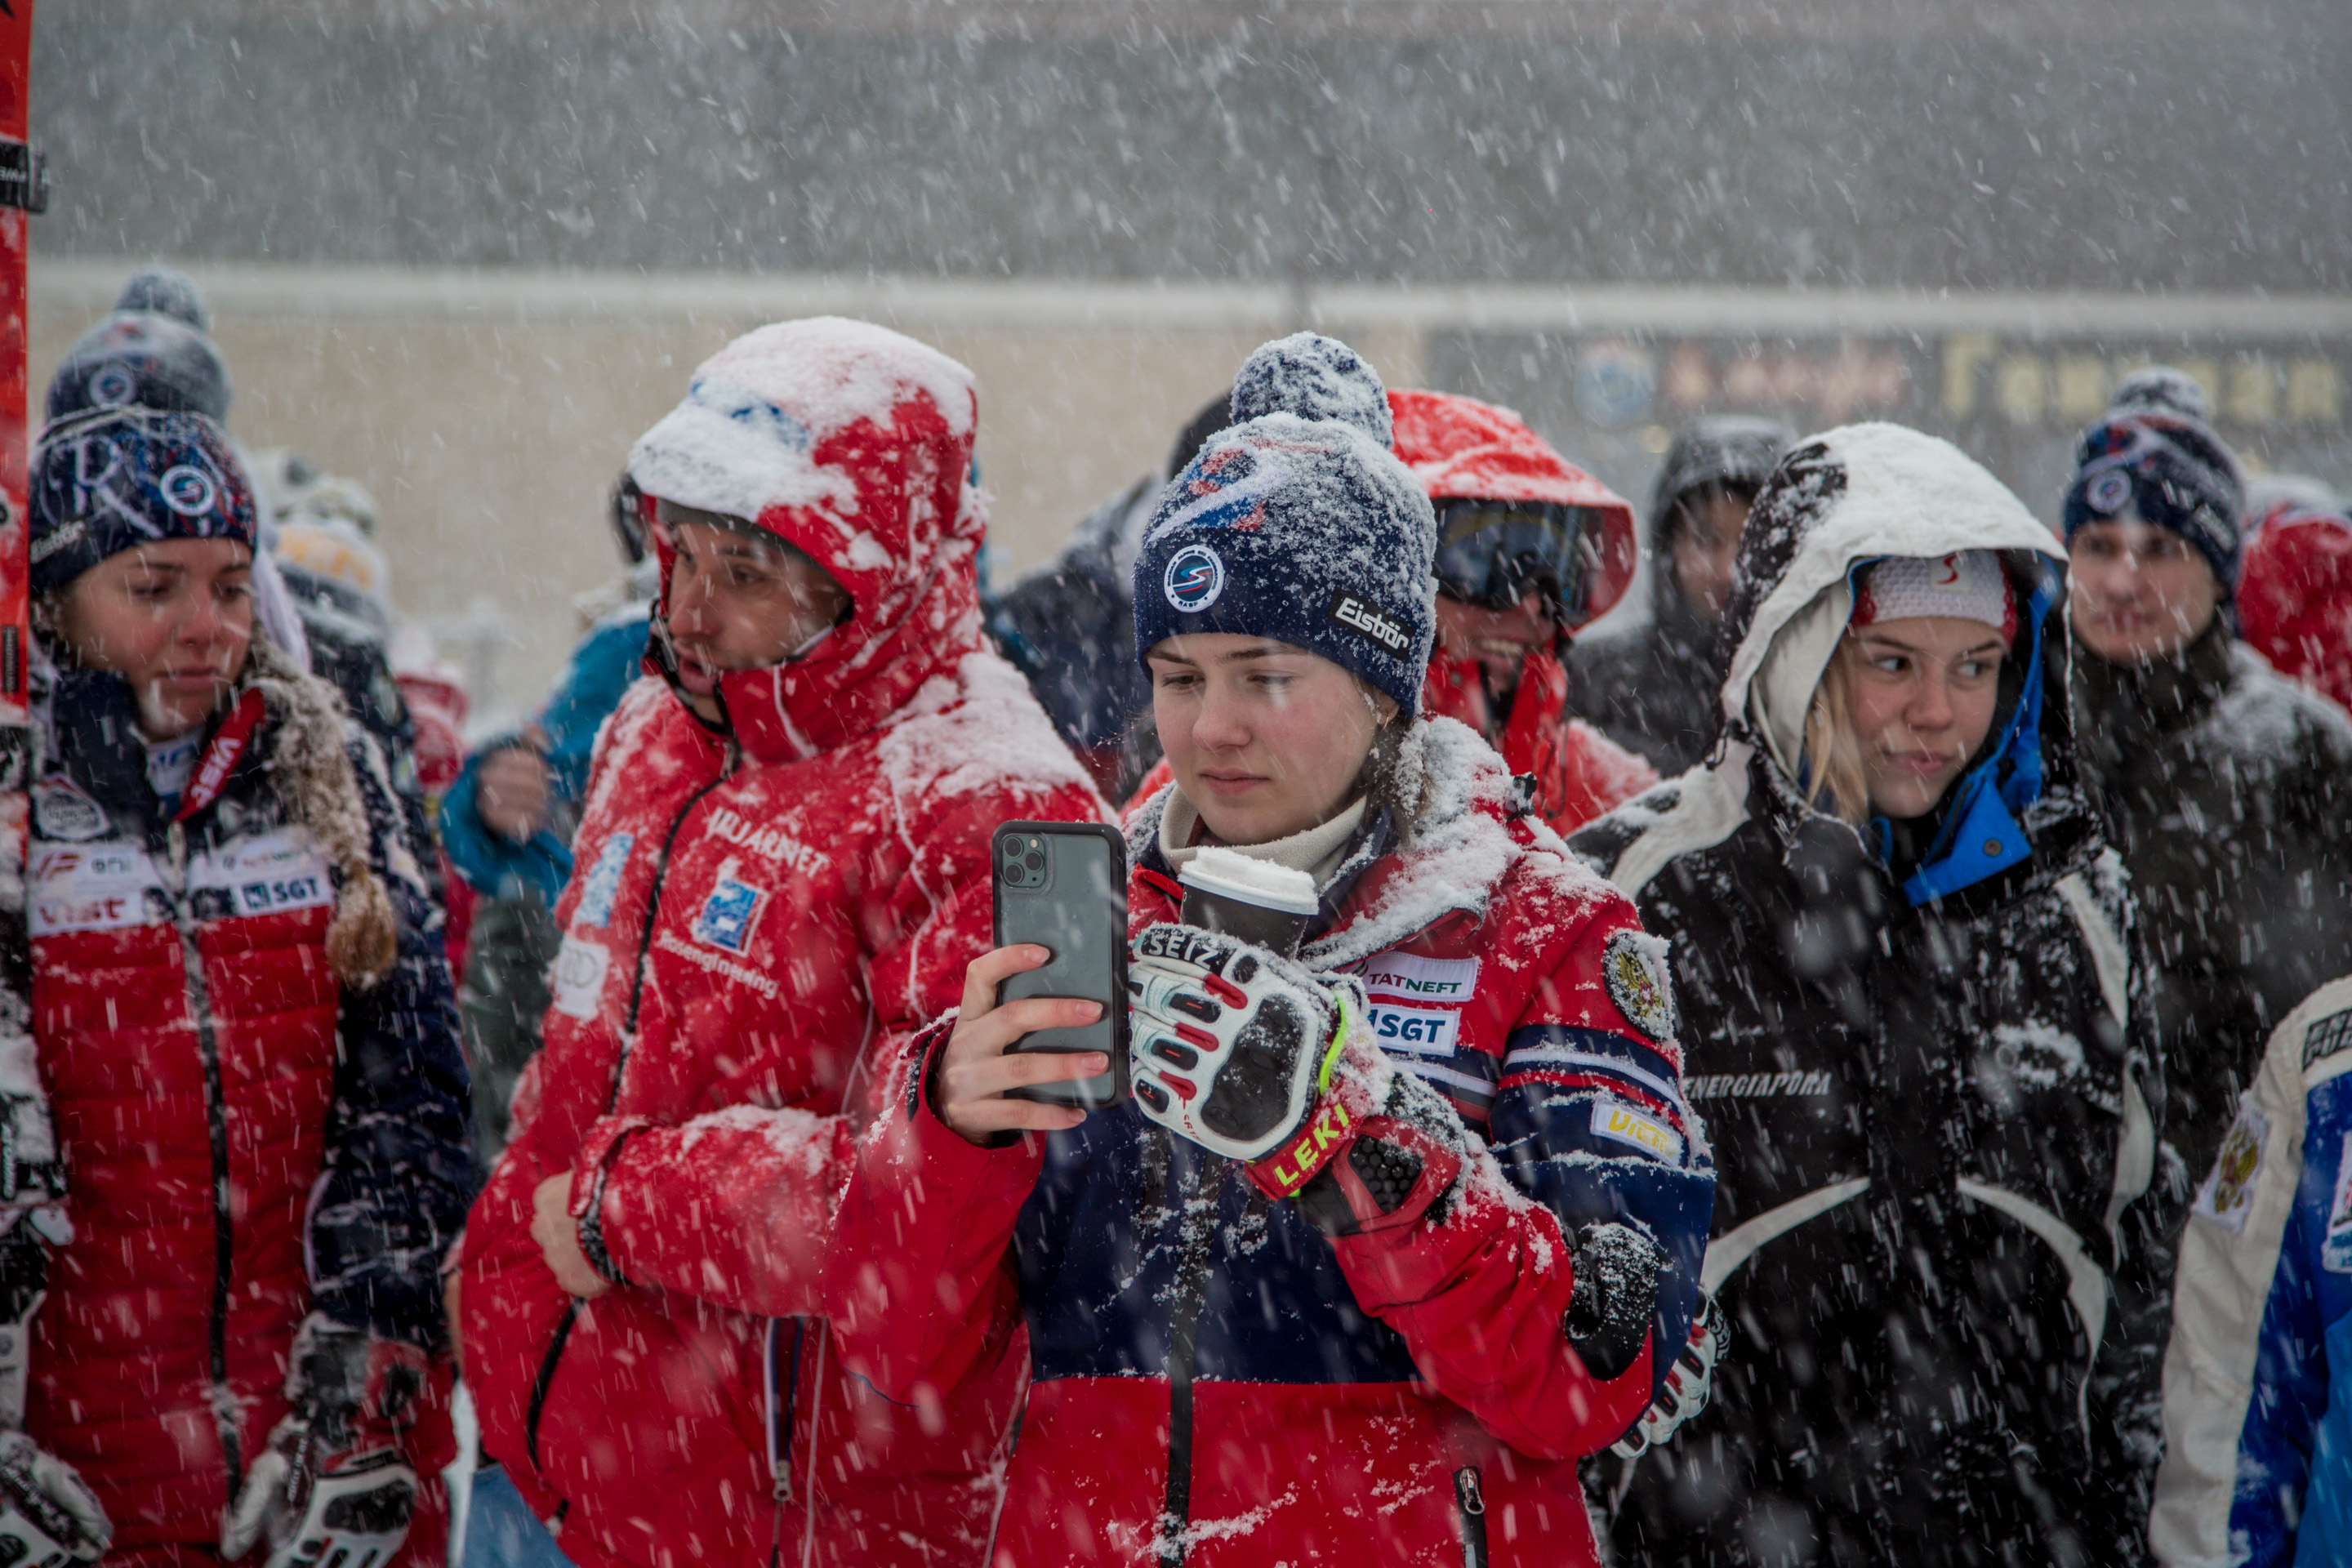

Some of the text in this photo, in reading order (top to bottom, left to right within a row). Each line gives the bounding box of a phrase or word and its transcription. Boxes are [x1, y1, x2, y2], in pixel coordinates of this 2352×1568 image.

[1334, 596, 1410, 650] Eisbär
[273, 876, 318, 902] SGT
[1369, 973, 1463, 994] TATNEFT
[1377, 1013, 1446, 1044] SGT
[1274, 1102, 1349, 1187] LEKI
